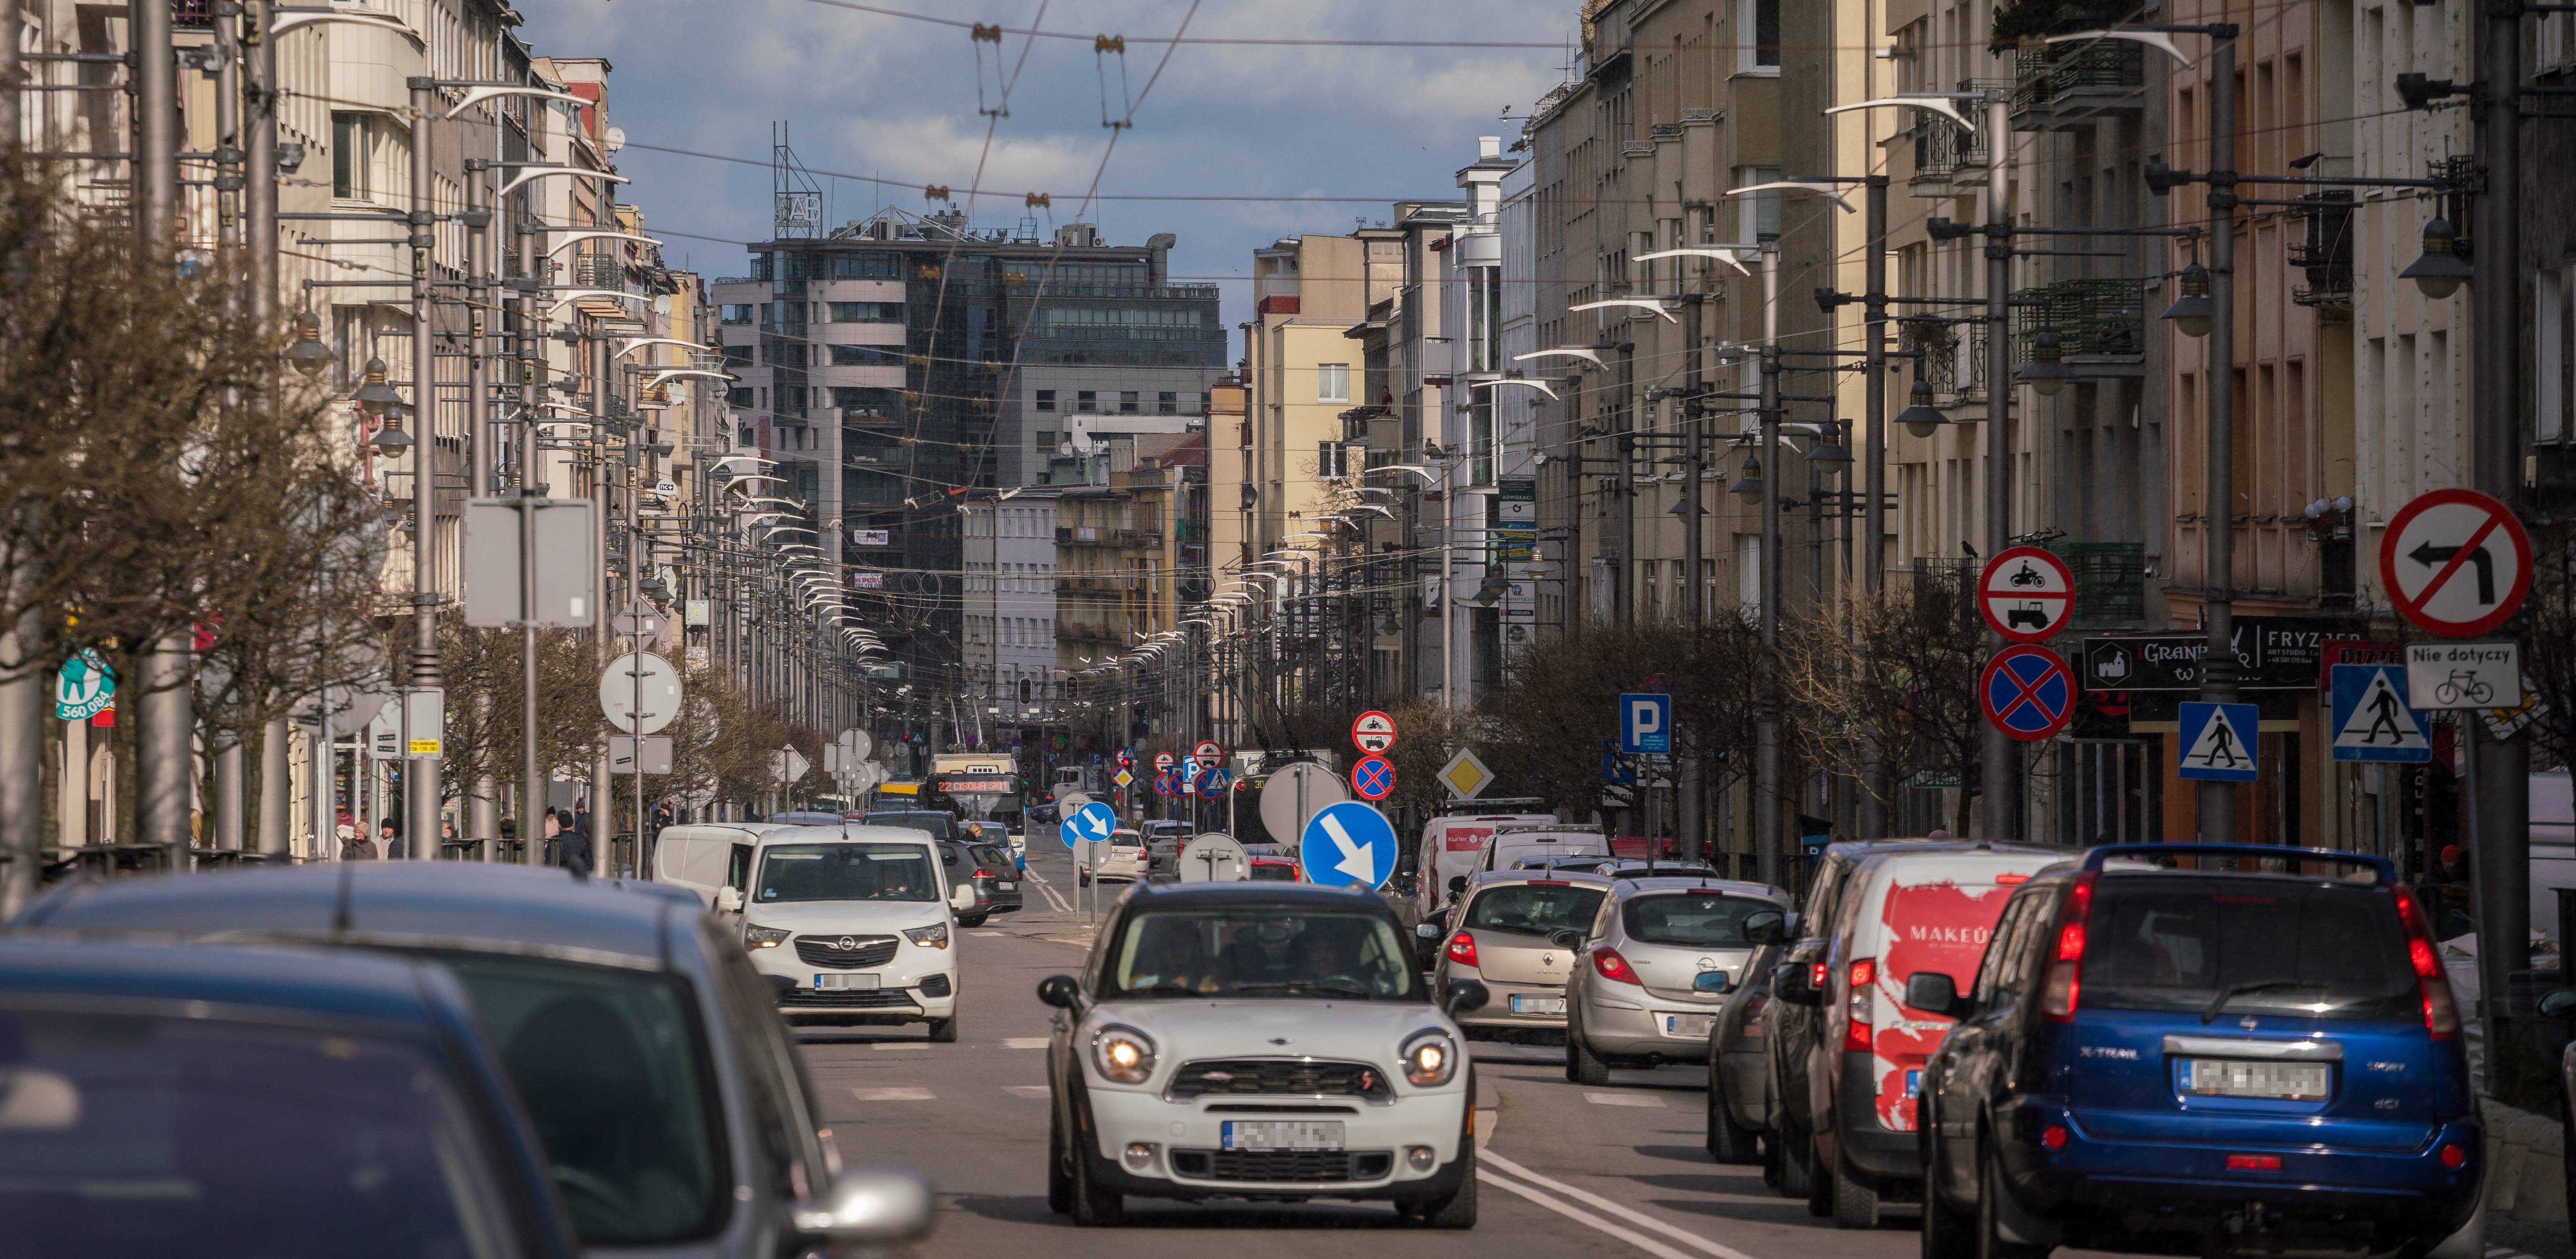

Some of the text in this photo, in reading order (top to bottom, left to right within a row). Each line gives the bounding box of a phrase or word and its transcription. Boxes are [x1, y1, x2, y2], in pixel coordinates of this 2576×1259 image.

[2413, 647, 2510, 665] Nie dotyczy
[62, 690, 110, 718] 560 084
[1632, 701, 1660, 746] P
[1188, 762, 1200, 779] P
[938, 781, 1007, 791] 22 CISOWA SKM
[2079, 1046, 2142, 1060] X-TRAIL
